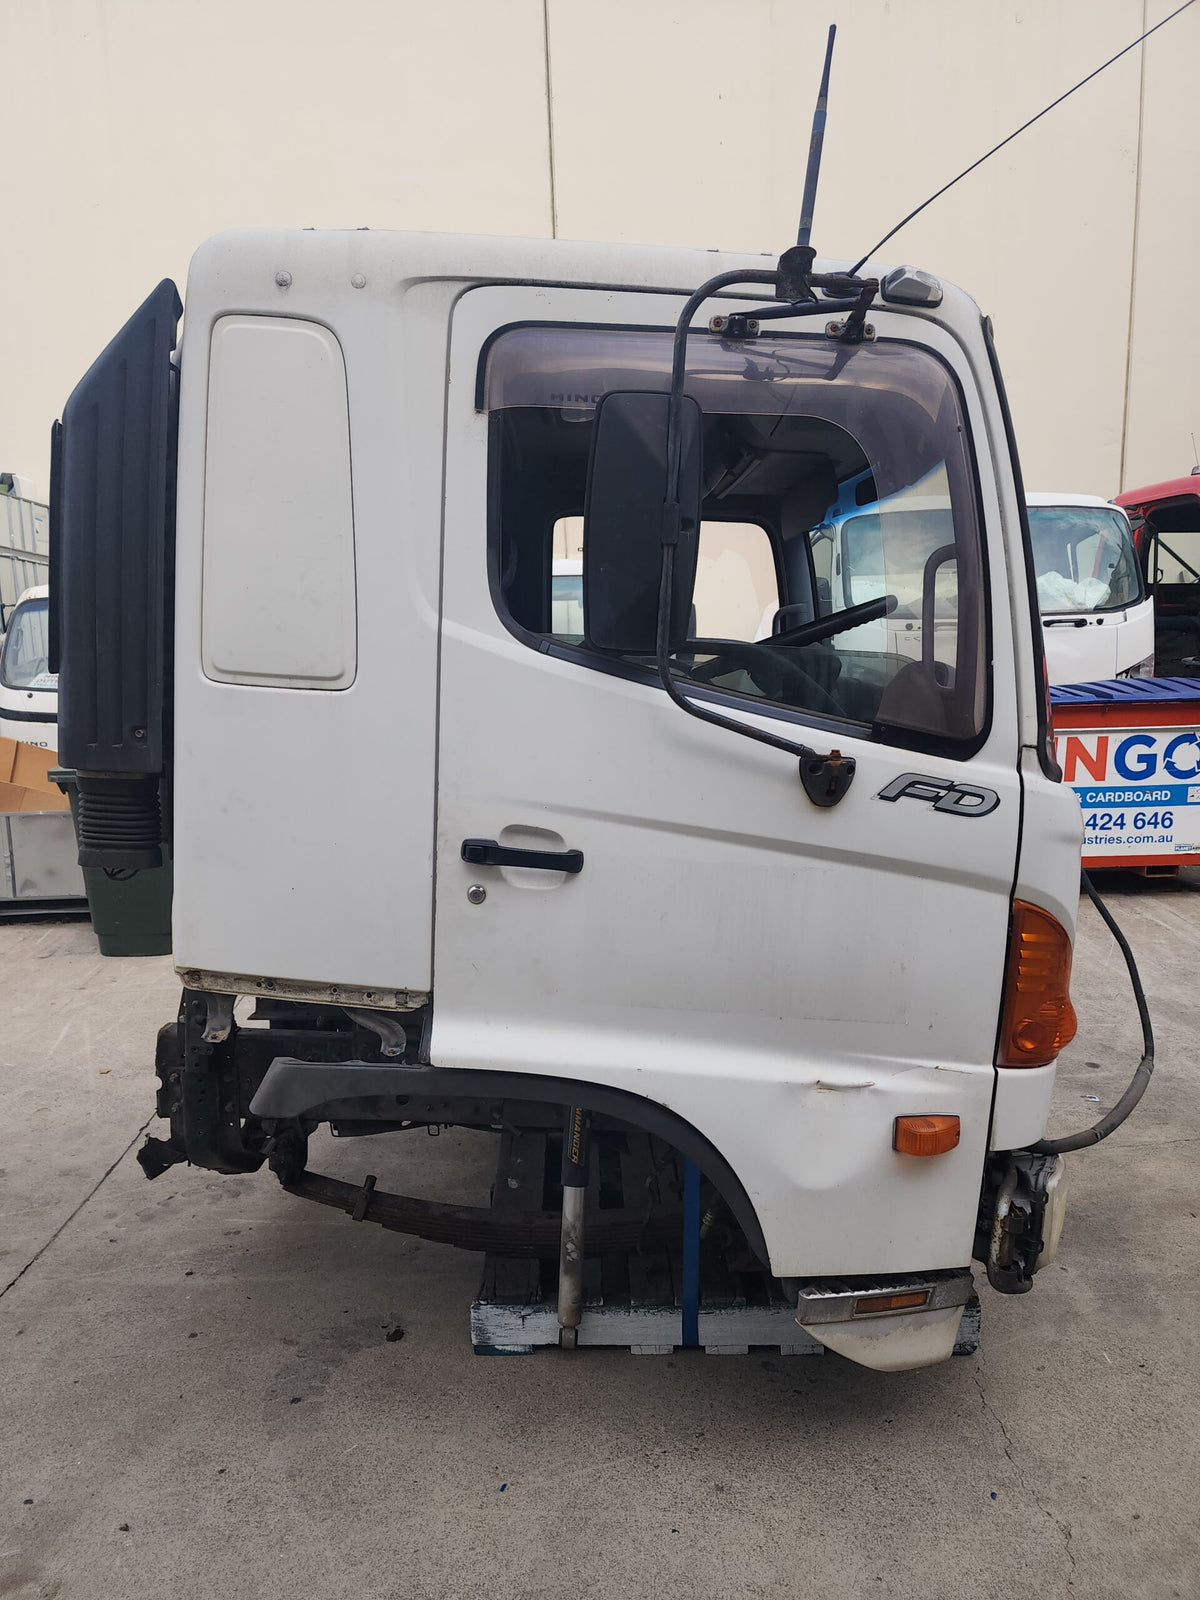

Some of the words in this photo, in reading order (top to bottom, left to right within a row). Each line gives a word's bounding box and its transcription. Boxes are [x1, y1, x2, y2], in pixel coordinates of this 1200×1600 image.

[1055, 732, 1200, 782] NGO
[877, 772, 1001, 817] FD
[1086, 791, 1171, 803] CARDBOARD
[1085, 813, 1126, 831] 424
[1133, 811, 1174, 830] 646
